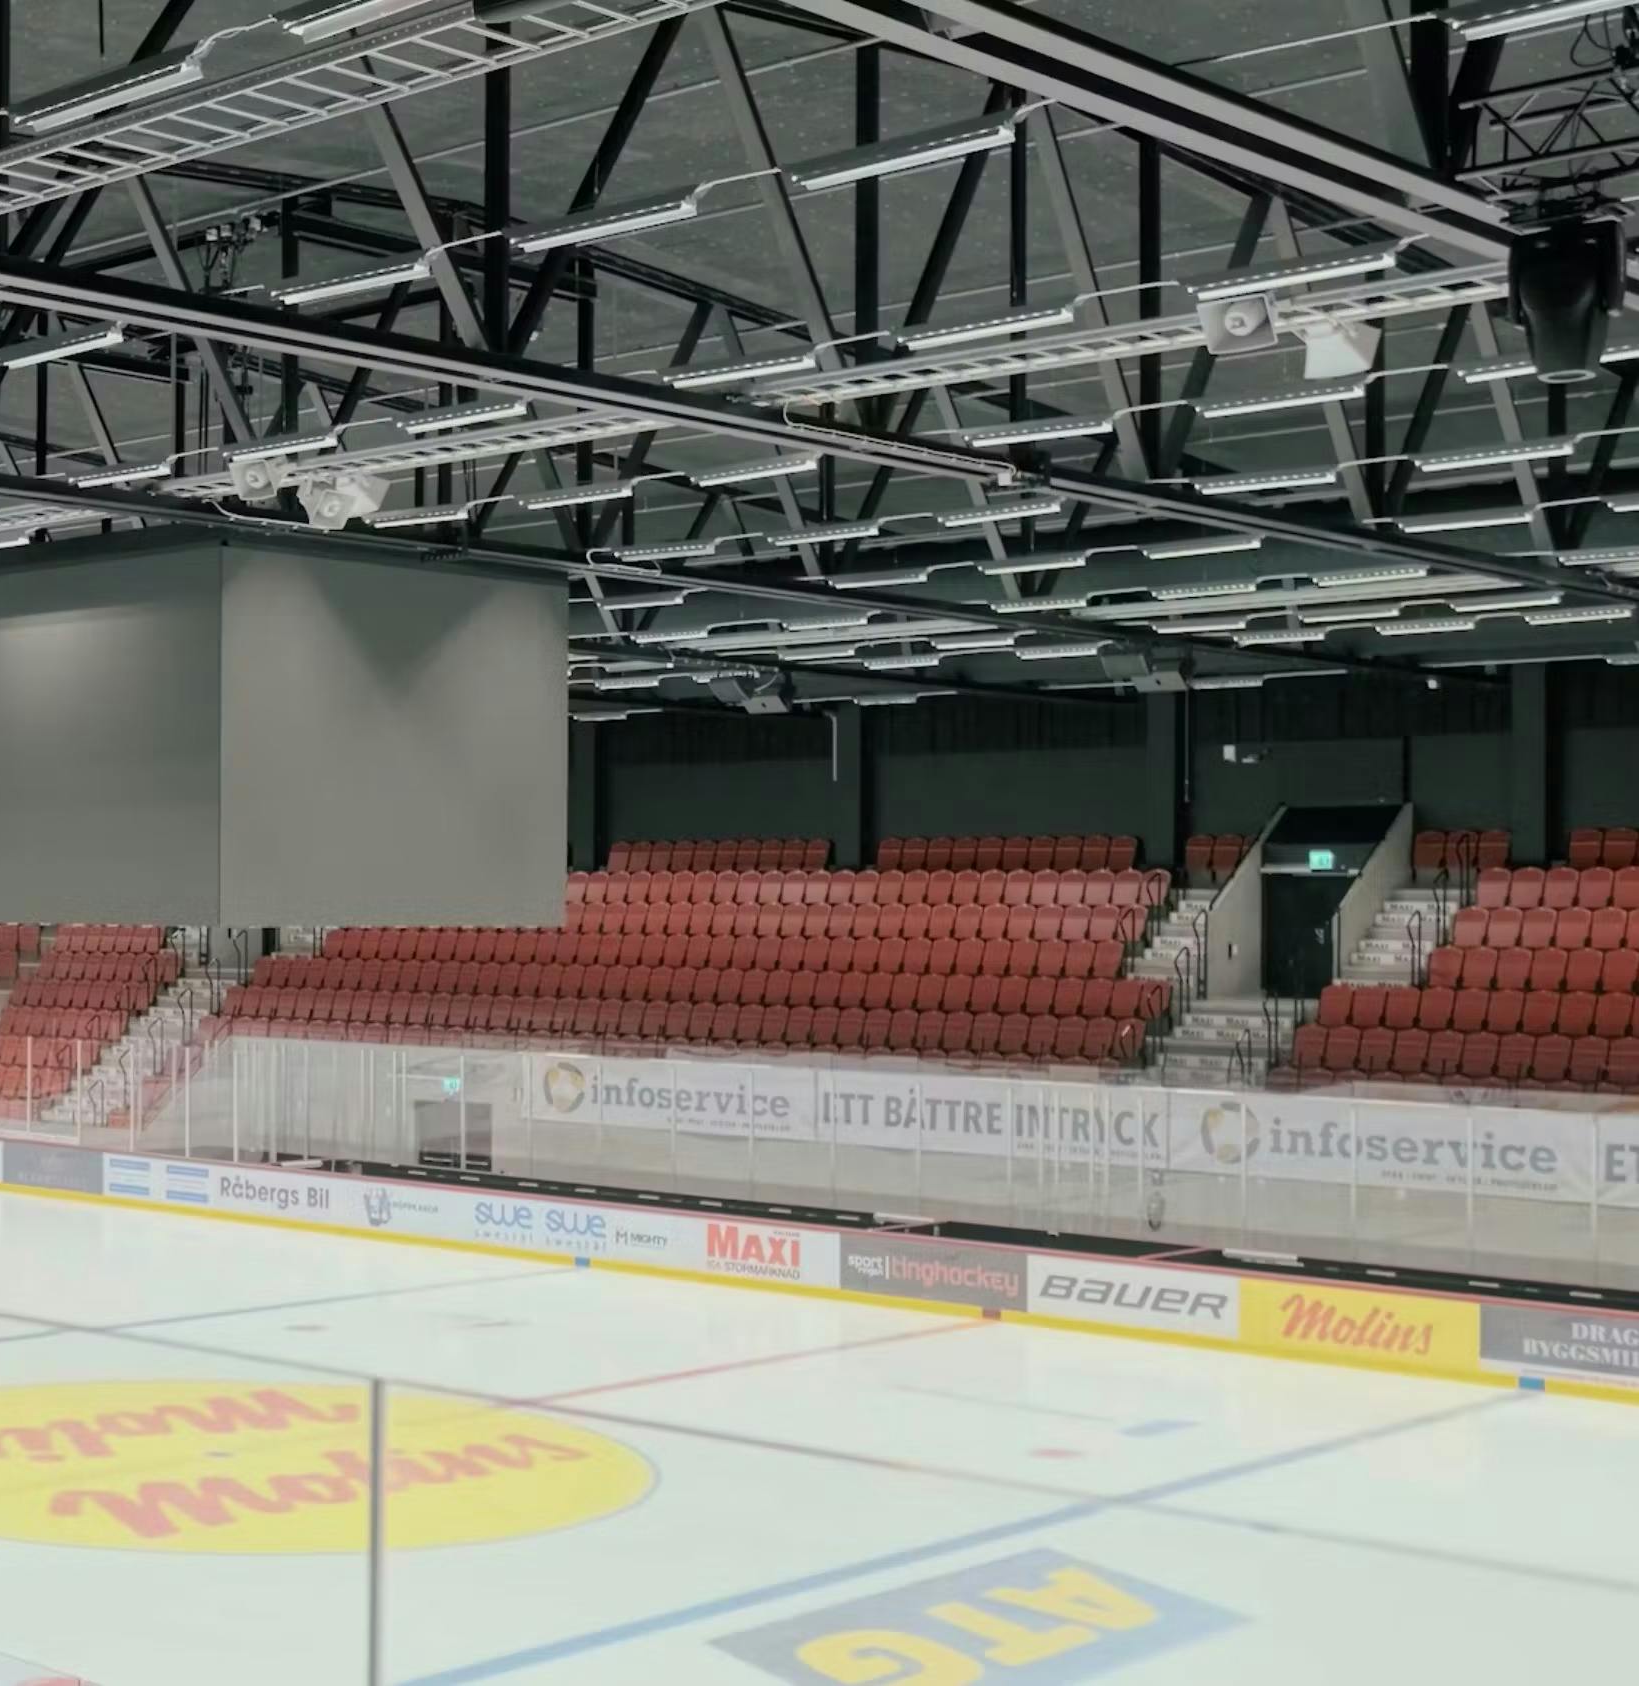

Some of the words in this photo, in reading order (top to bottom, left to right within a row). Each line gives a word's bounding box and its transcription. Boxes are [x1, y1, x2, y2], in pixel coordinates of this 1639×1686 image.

[591, 1076, 791, 1118] infoservice
[823, 1091, 875, 1126] ETT
[1015, 1103, 1160, 1149] INTRYCK
[1270, 1117, 1558, 1174] infoservice
[307, 1187, 330, 1209] Bil
[707, 1223, 800, 1268] MAXI
[847, 1255, 884, 1269] sport
[1039, 1271, 1229, 1321] BAUER
[1279, 1293, 1433, 1356] Molins
[49, 1432, 591, 1540] Molins
[794, 1566, 1159, 1686] ATG
